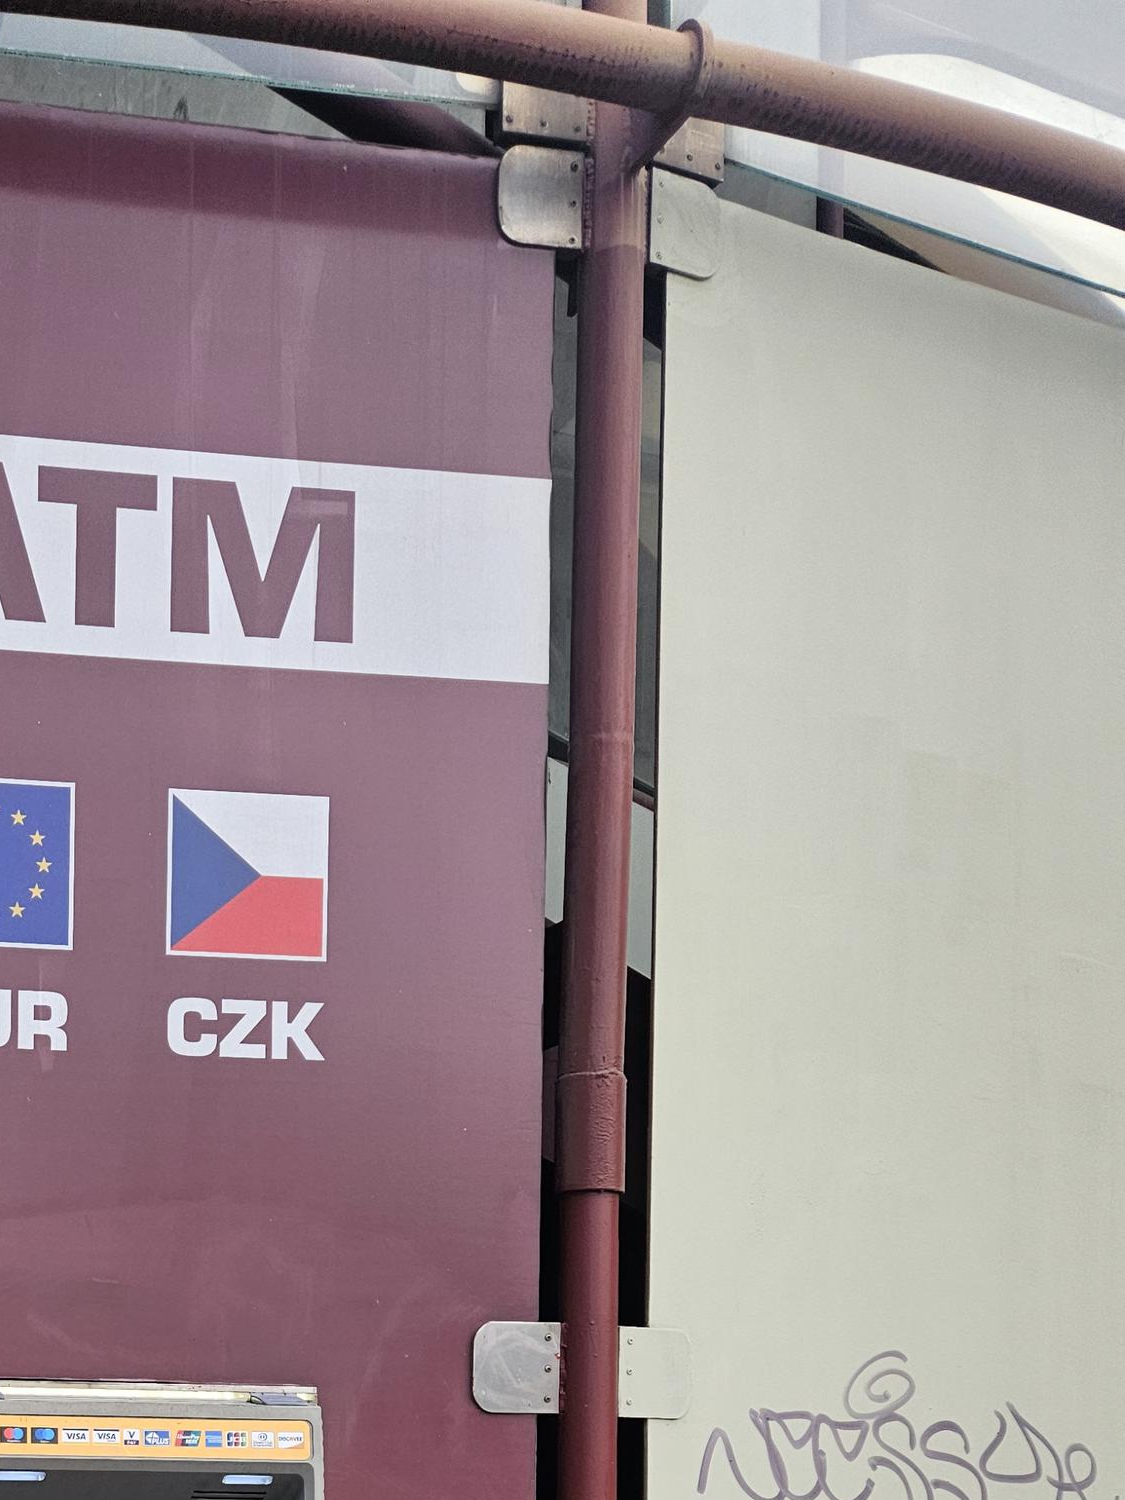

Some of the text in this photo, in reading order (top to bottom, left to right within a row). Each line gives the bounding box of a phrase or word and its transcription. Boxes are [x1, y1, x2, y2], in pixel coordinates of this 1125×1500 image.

[166, 997, 325, 1062] CZK
[66, 1432, 86, 1440] VISA
[97, 1432, 117, 1440] VISA
[152, 1437, 169, 1445] PLUS
